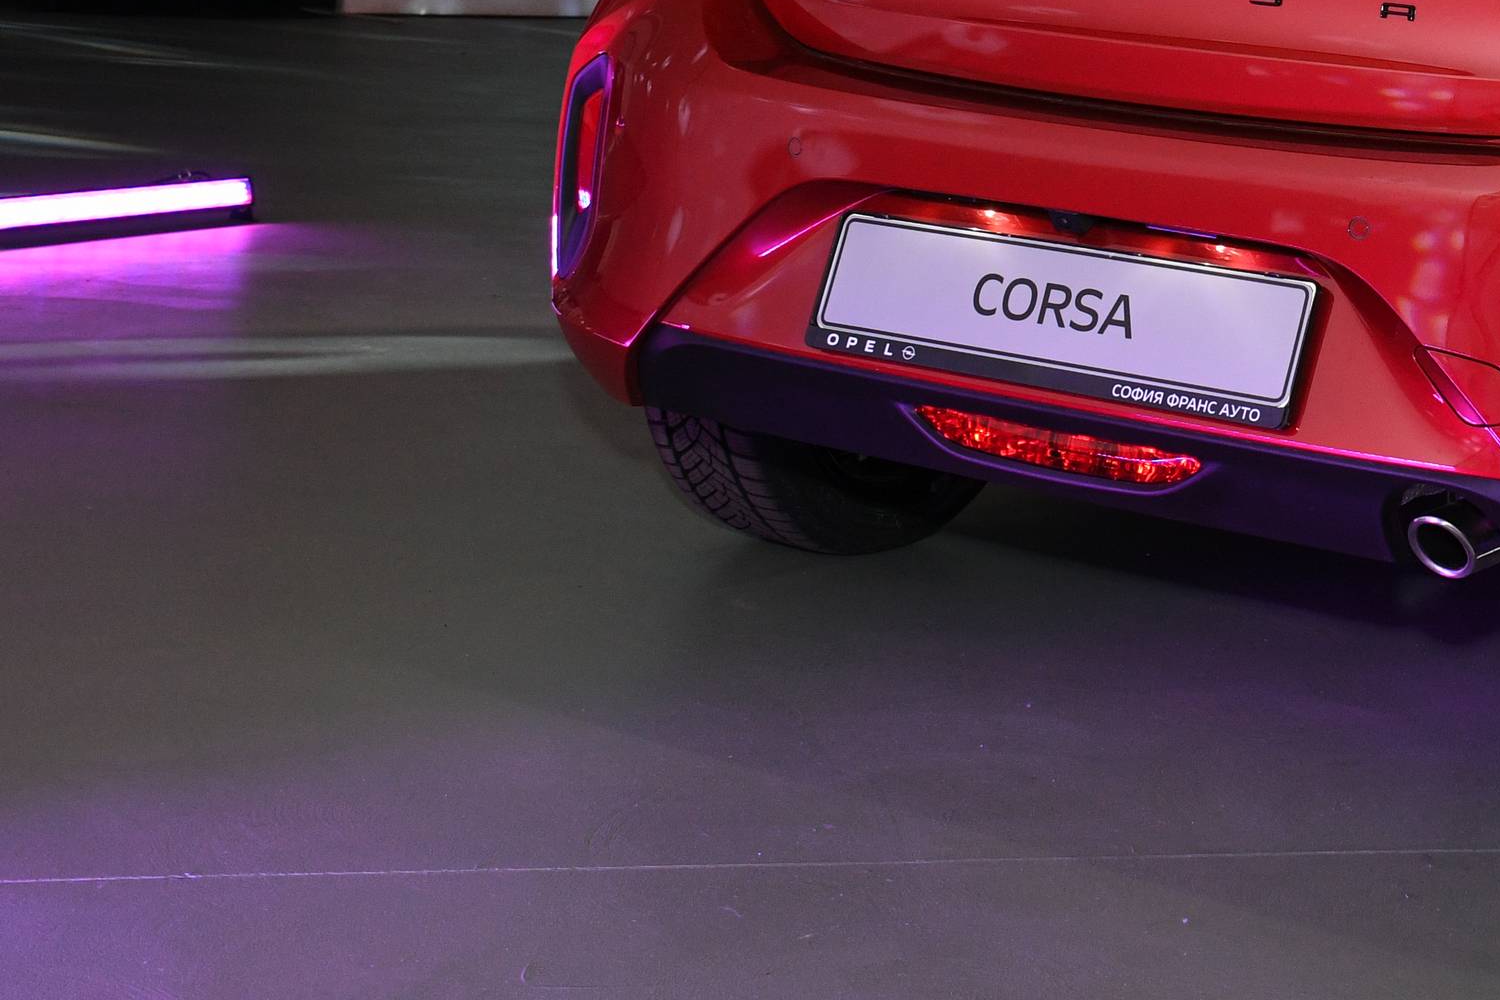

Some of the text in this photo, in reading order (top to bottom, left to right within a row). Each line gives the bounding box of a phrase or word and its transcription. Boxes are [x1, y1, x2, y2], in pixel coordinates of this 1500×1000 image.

[972, 272, 1133, 340] CORSA
[826, 332, 893, 357] OPEL
[1111, 383, 1261, 423] СОФИЯ ФРАНС АУТО
